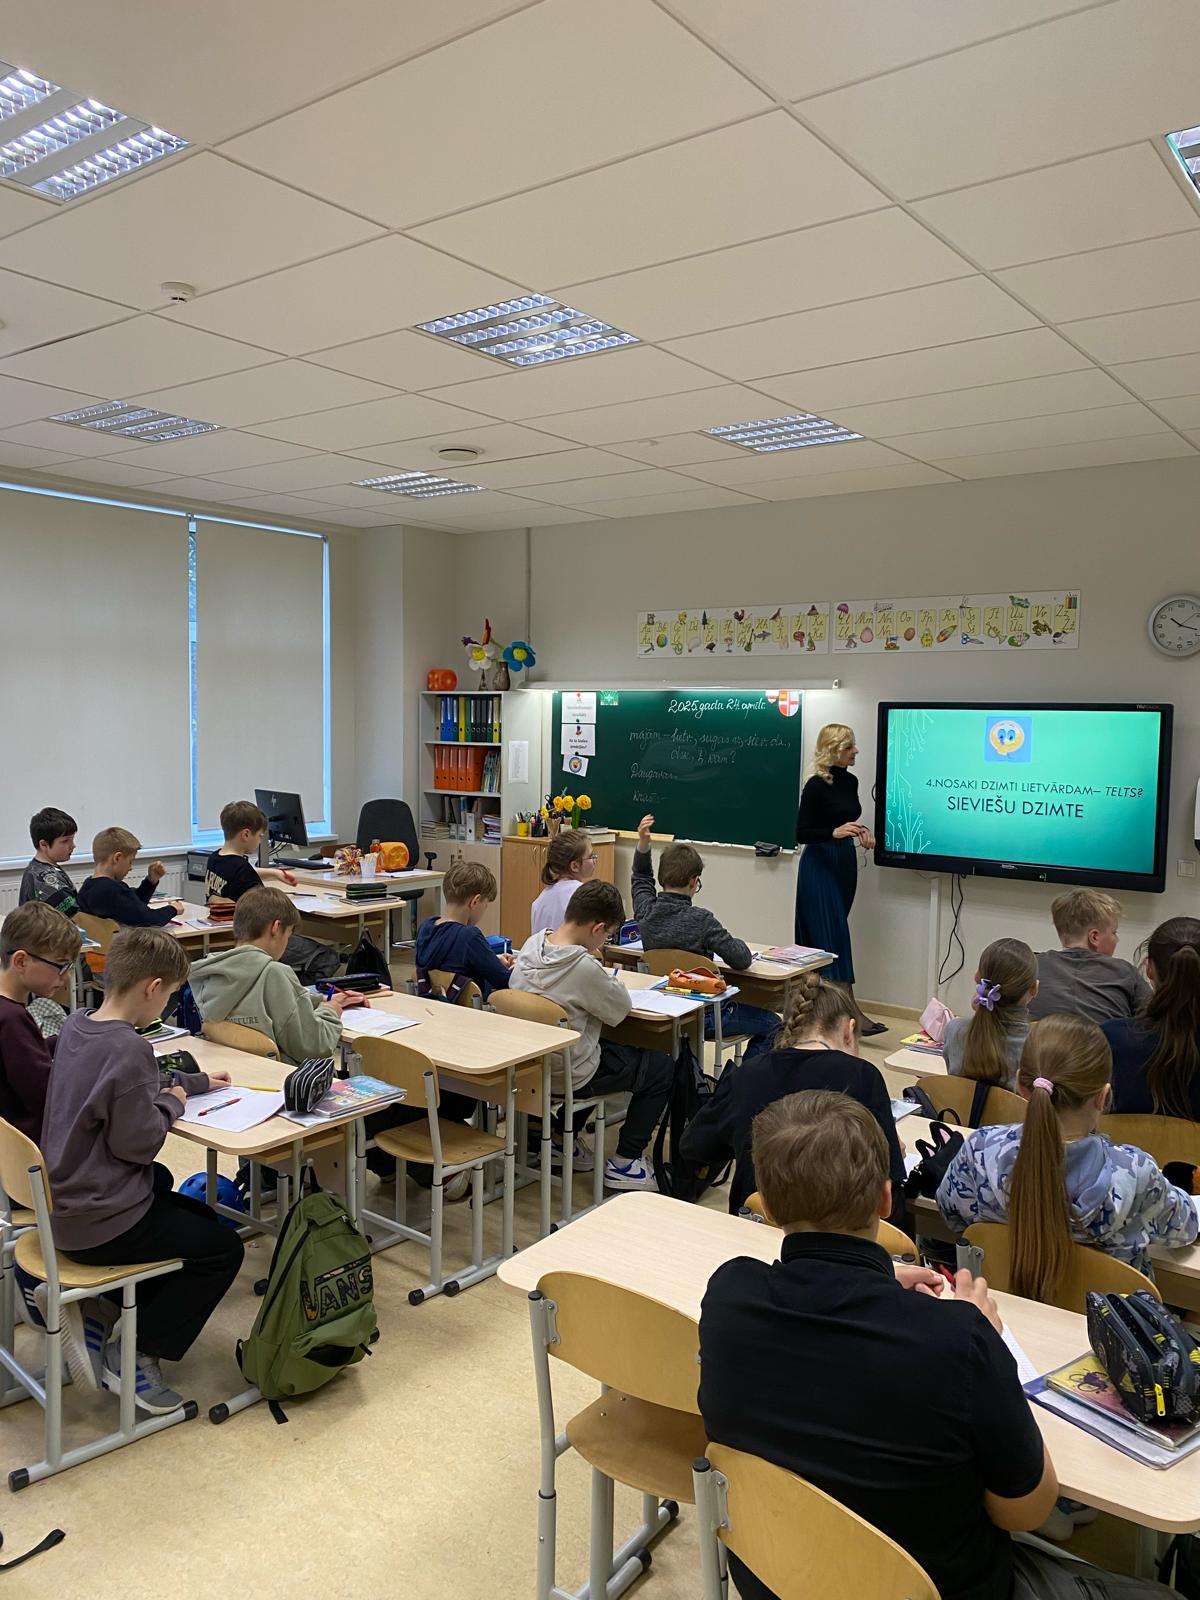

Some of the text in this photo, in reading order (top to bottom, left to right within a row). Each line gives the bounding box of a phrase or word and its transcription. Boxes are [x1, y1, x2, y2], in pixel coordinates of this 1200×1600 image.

[926, 778, 978, 790] 4.NOSAKI
[981, 780, 1018, 792] DZIMTI
[1105, 786, 1144, 798] TELTS?
[947, 795, 1085, 818] SIEVIEŠU DZIMTE
[300, 1262, 374, 1322] VANS
